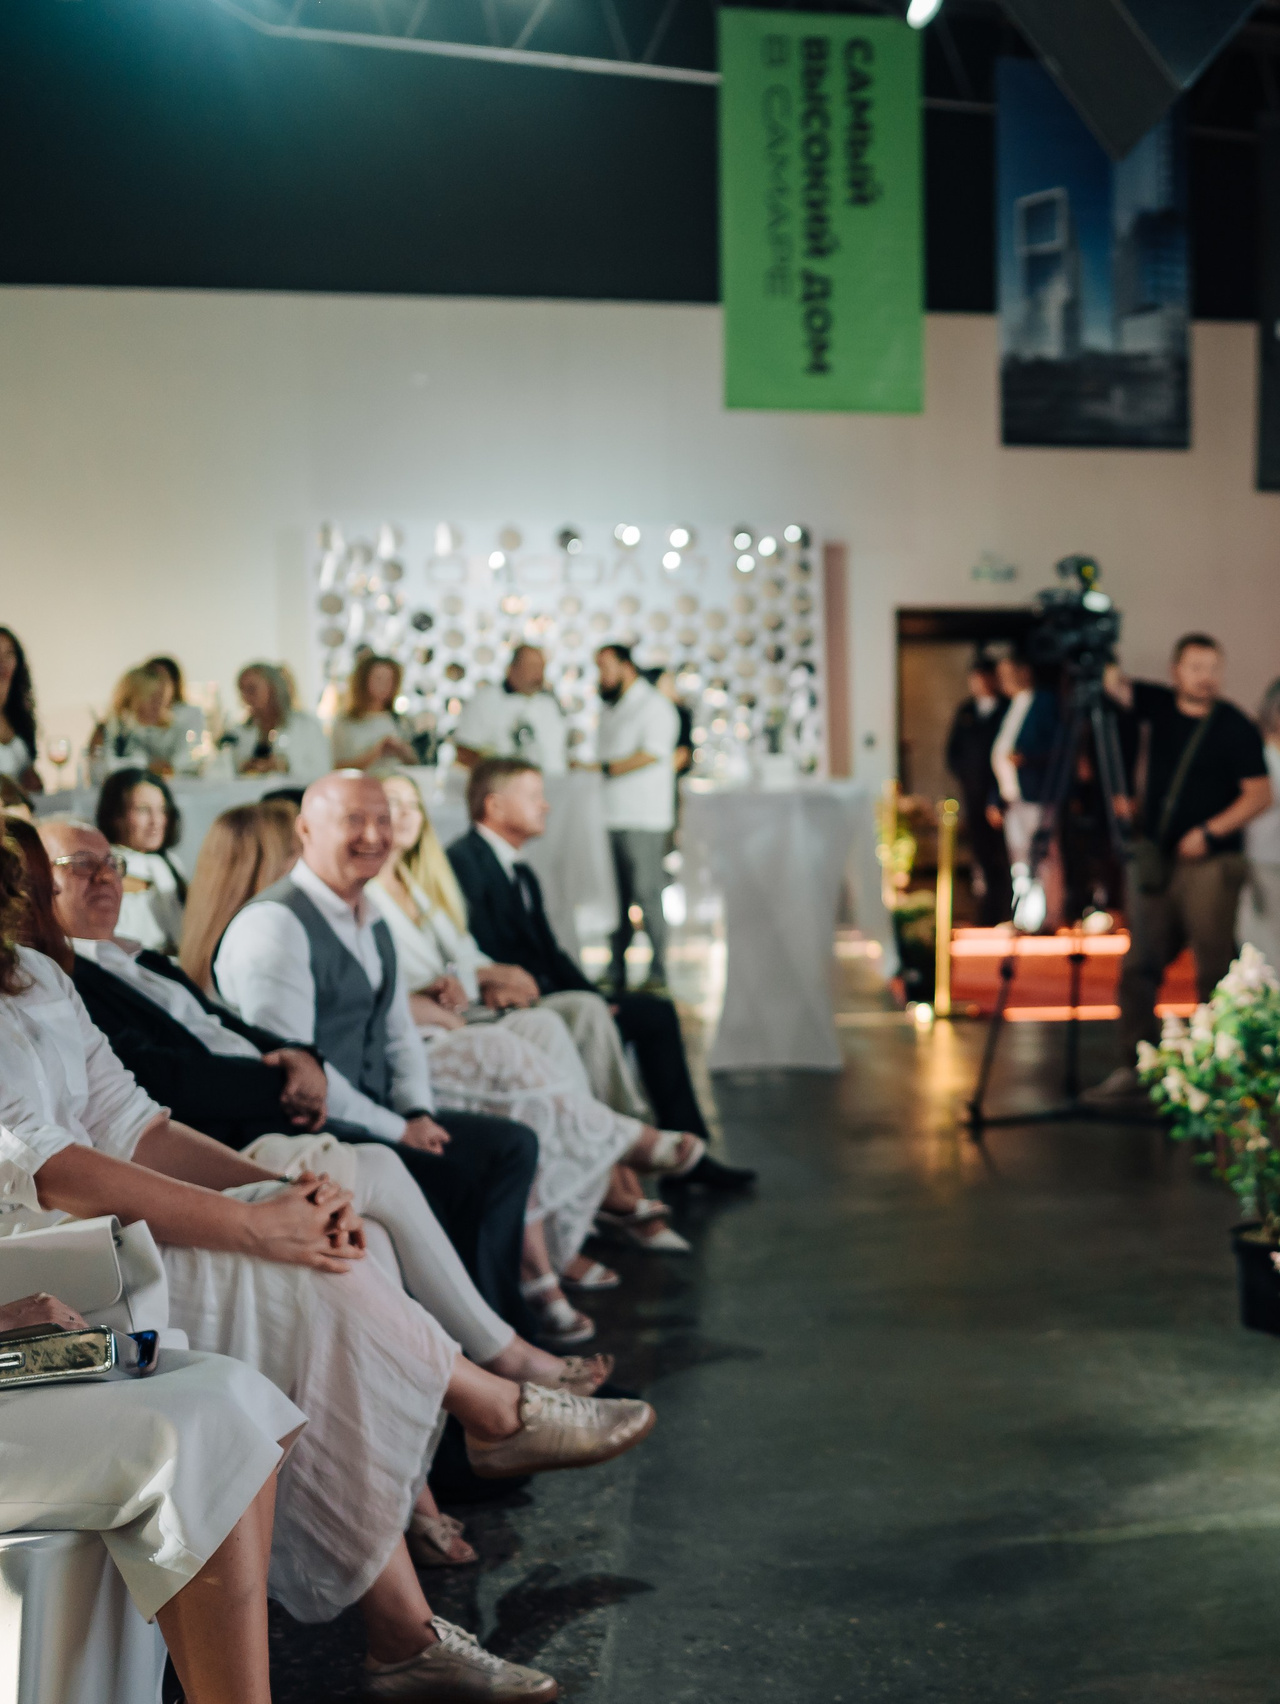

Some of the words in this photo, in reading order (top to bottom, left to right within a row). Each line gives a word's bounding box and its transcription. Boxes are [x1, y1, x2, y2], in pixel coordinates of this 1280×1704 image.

[763, 83, 793, 298] САМАРЕ
[801, 36, 840, 260] ВЫСОКИЙ
[844, 36, 883, 207] САМЫЙ
[801, 267, 832, 375] ДОМ
